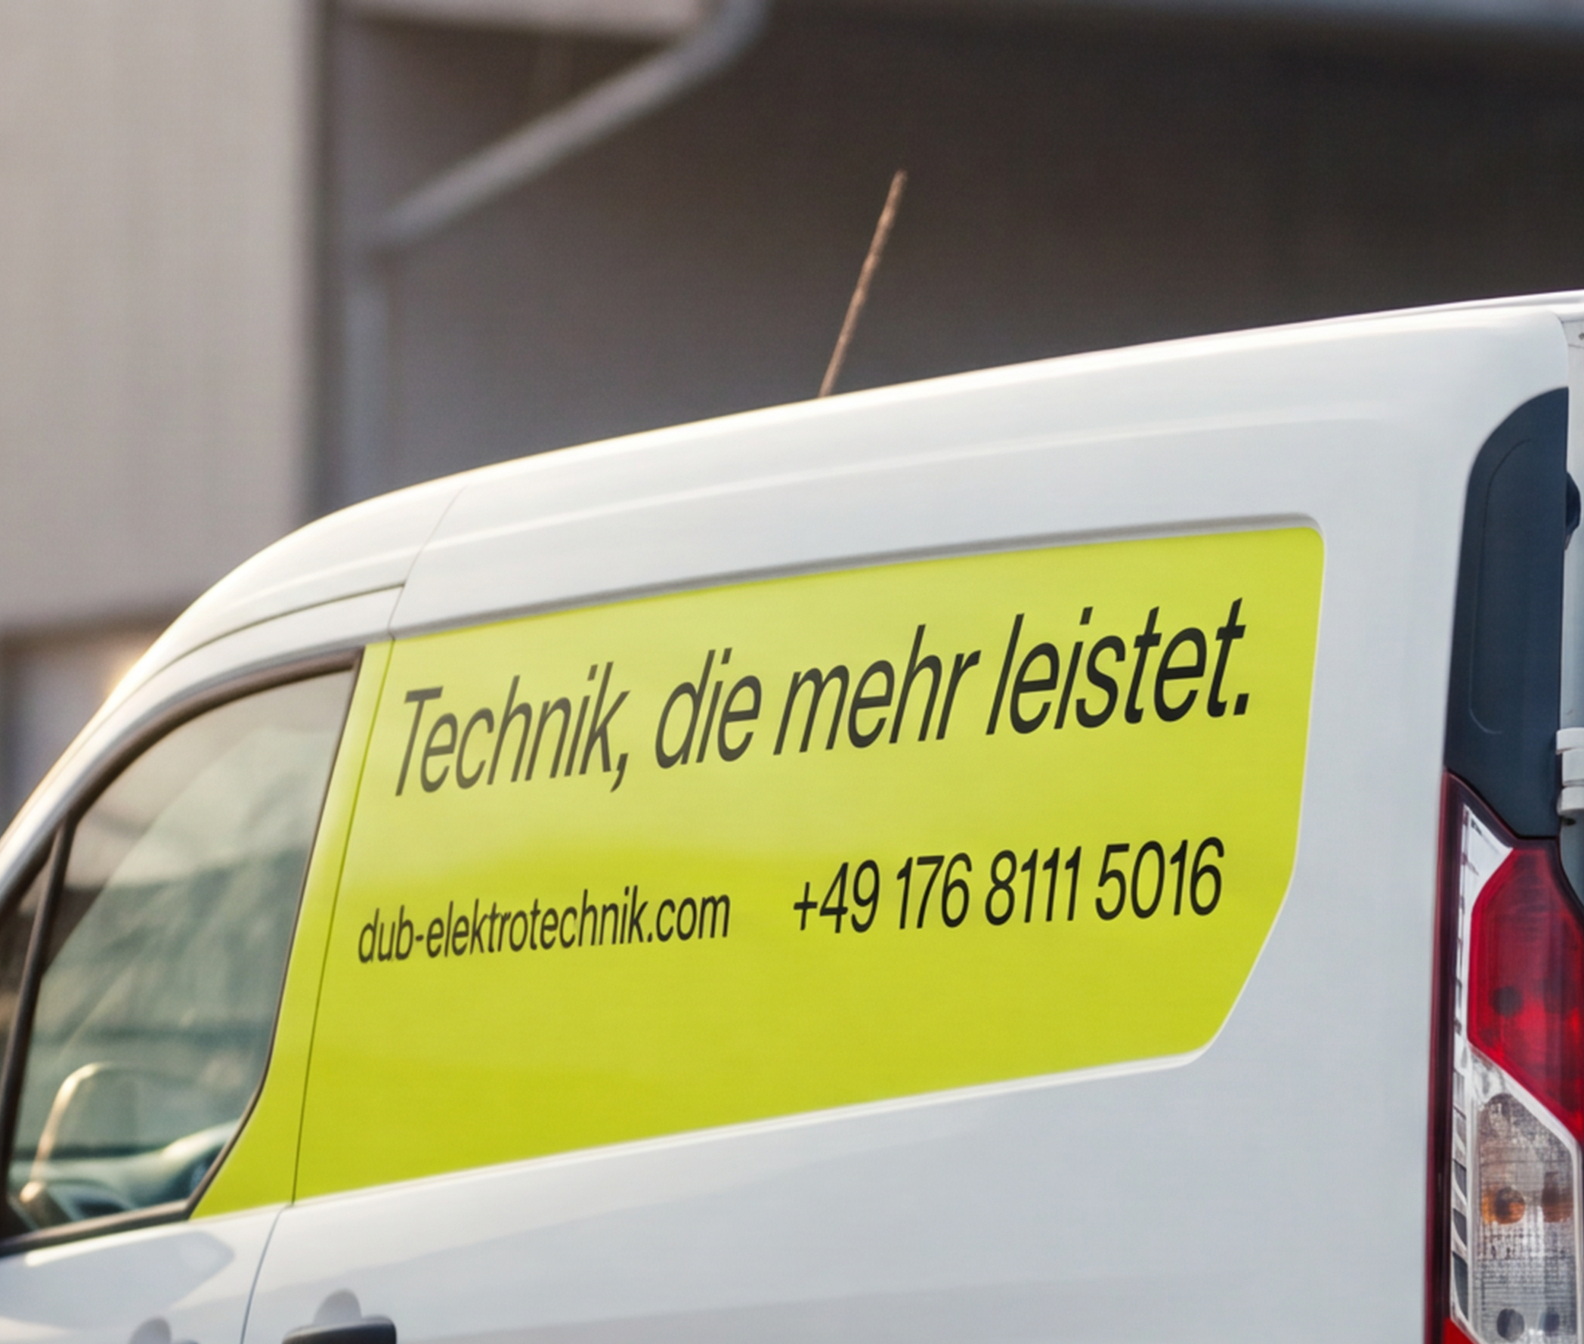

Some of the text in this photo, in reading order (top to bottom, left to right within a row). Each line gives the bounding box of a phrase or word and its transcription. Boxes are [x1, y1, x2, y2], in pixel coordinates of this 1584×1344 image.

[394, 598, 1250, 796] Technik, die mehr leistet.
[358, 837, 1225, 964] dub-elektrotechnik.com +49 176 8111 5016
